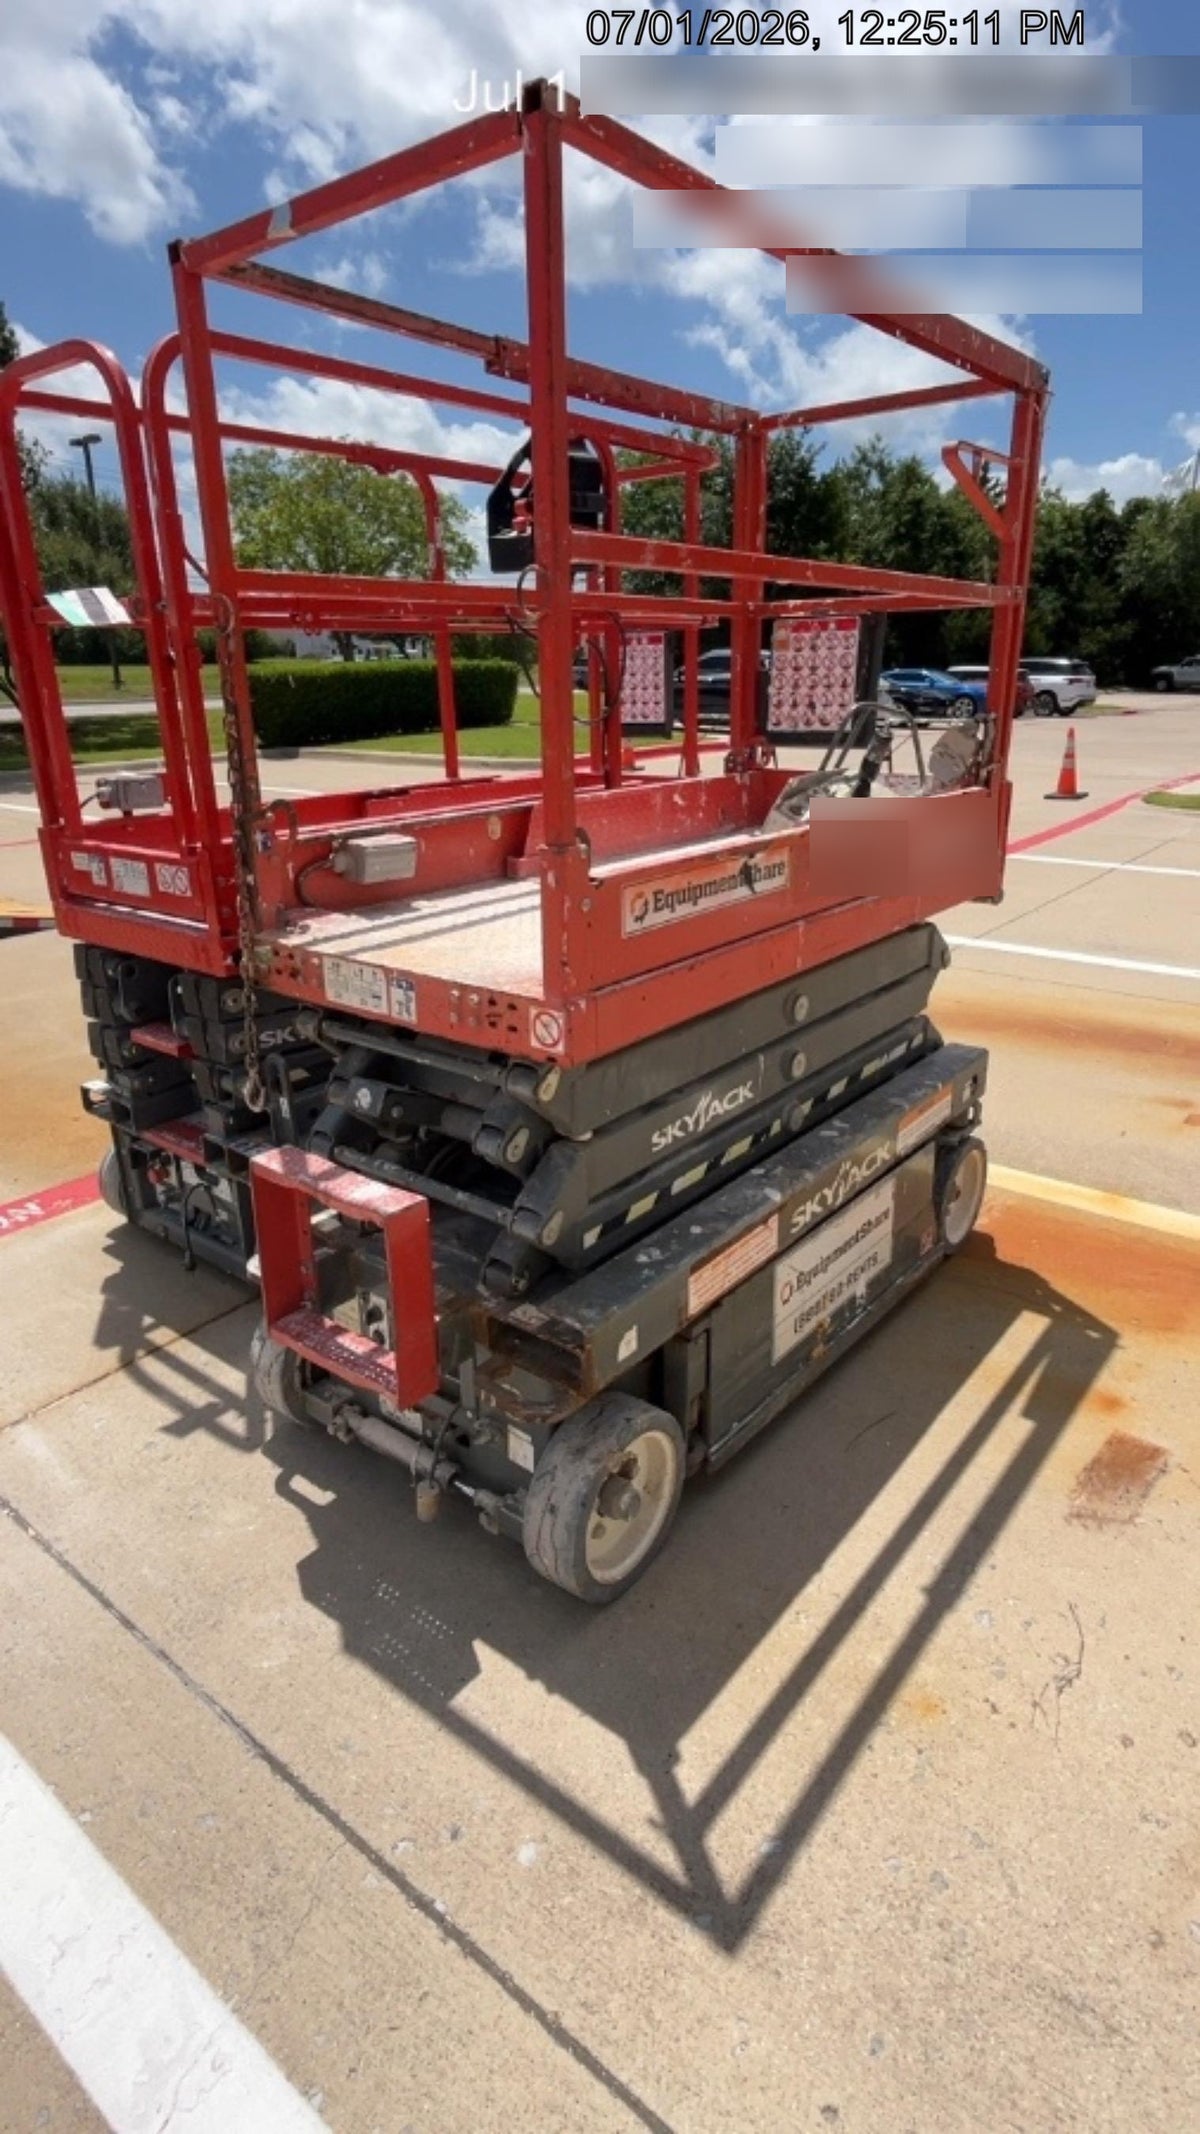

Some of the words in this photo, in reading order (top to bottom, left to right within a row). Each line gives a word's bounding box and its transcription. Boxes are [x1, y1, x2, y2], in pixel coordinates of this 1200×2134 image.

[651, 861, 786, 913] Equipmenthare
[651, 1080, 755, 1153] SKYJACK
[790, 1140, 892, 1234] SKYJACK
